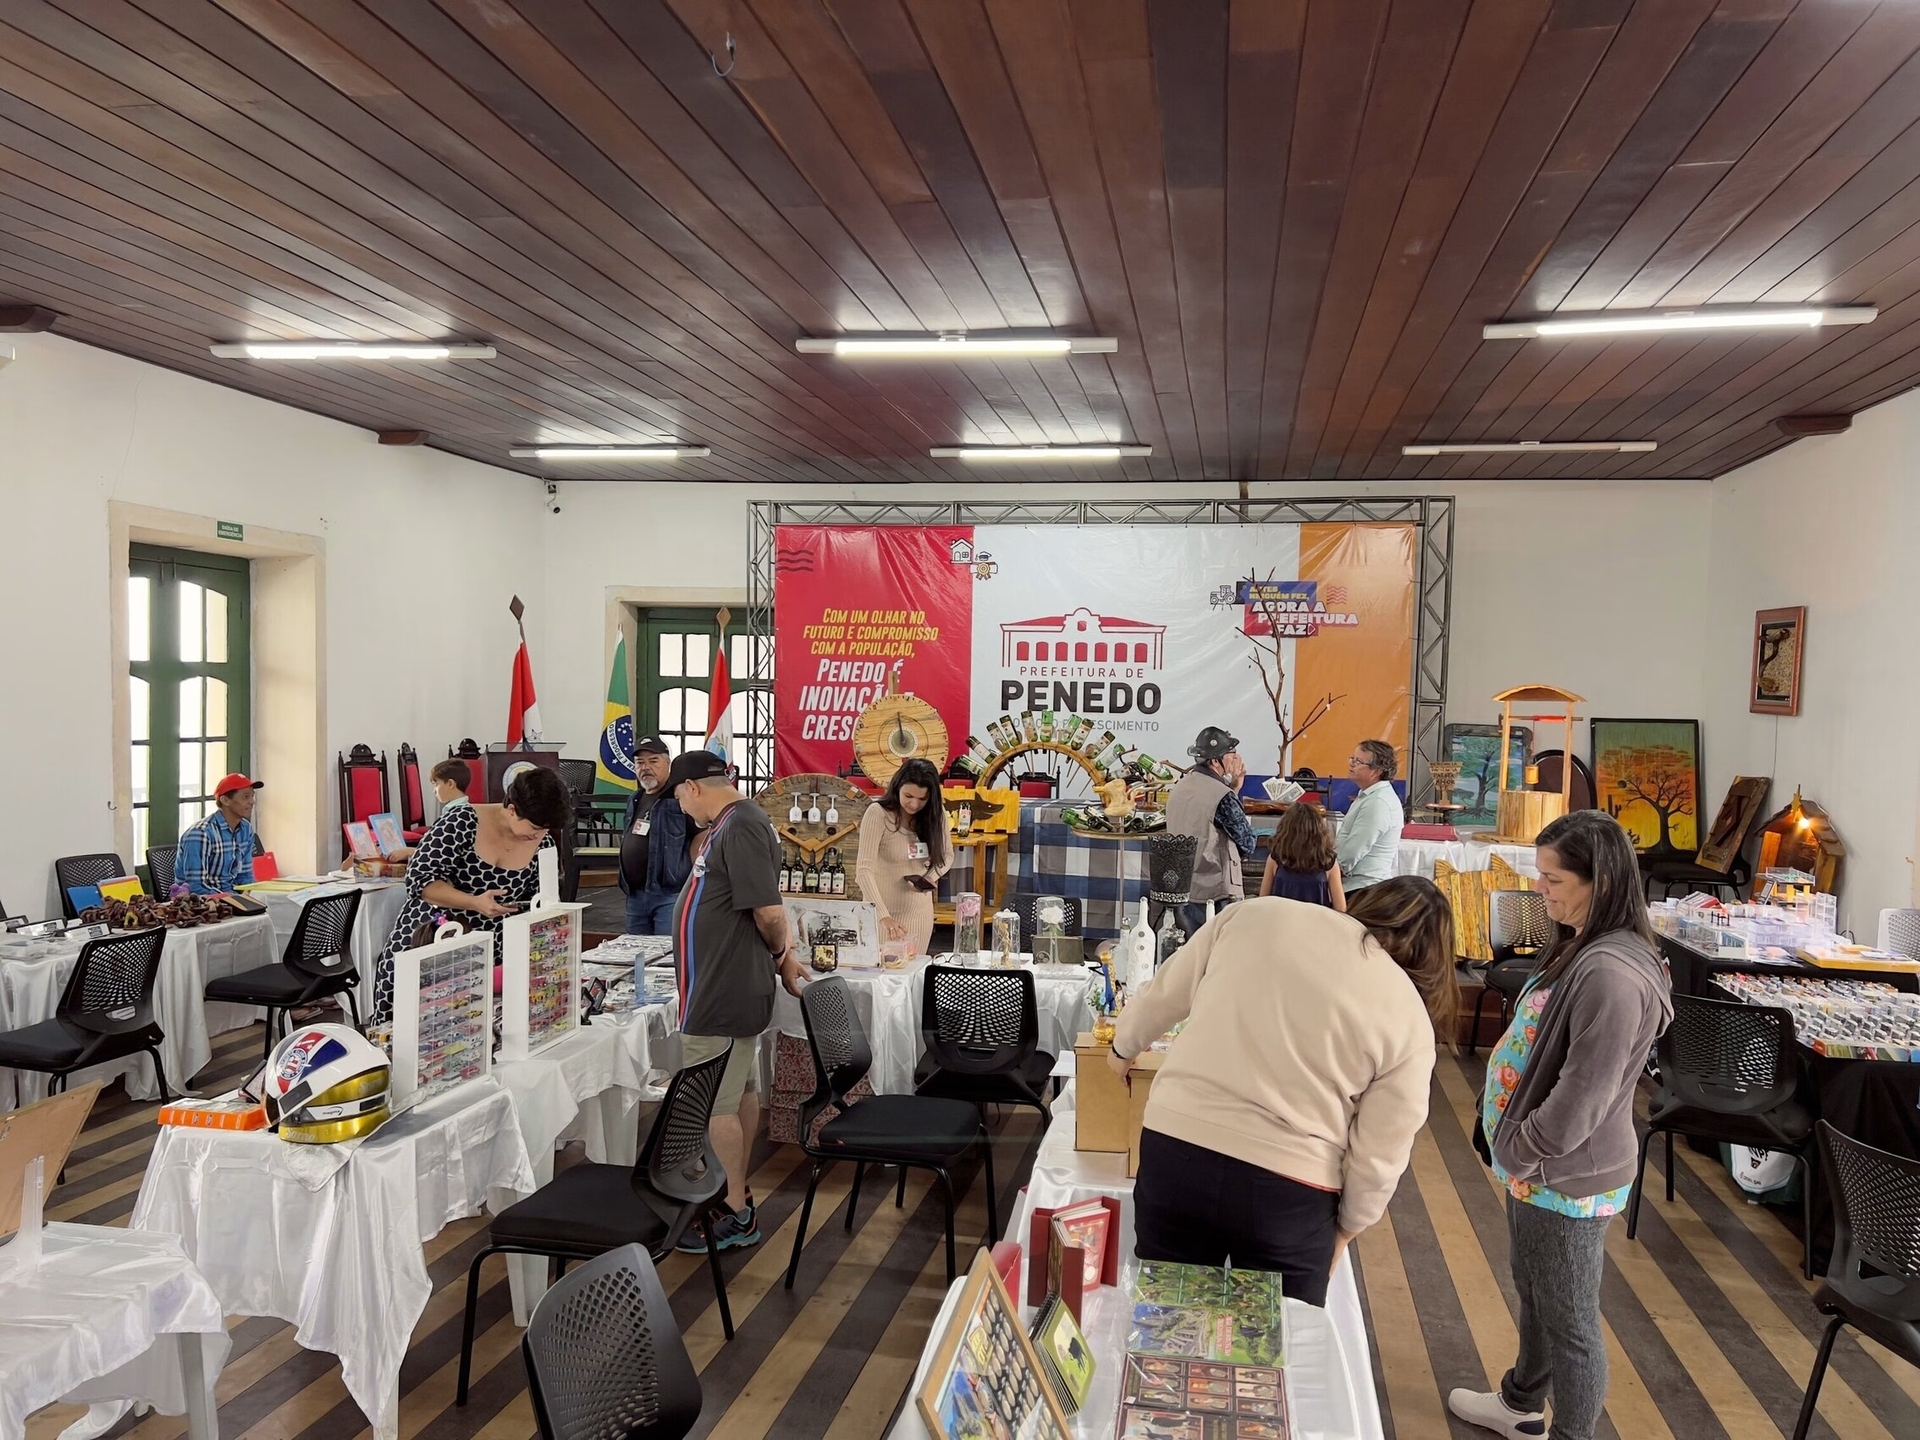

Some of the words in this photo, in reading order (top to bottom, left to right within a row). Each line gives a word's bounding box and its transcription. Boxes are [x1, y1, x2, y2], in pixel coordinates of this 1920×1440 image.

[1252, 601, 1310, 612] AGORA
[1312, 601, 1326, 612] A
[822, 608, 848, 624] COM
[850, 610, 868, 624] UM
[871, 610, 907, 624] OLHAR
[908, 611, 926, 624] NO
[803, 625, 845, 640] FUTURO
[847, 626, 855, 640] E
[856, 626, 939, 641] COMPROMISSO
[810, 641, 836, 655] COM
[838, 642, 846, 655] A
[848, 640, 916, 658] POPULAÇÃO,
[816, 658, 886, 683] PENEDO
[1020, 666, 1117, 678] PREFEITURA
[1125, 668, 1144, 678] DE
[799, 684, 890, 715] INOVAÇÃ
[1000, 680, 1162, 714] PENEDO
[802, 714, 858, 741] CRES
[1090, 720, 1159, 732] SCIMENTO
